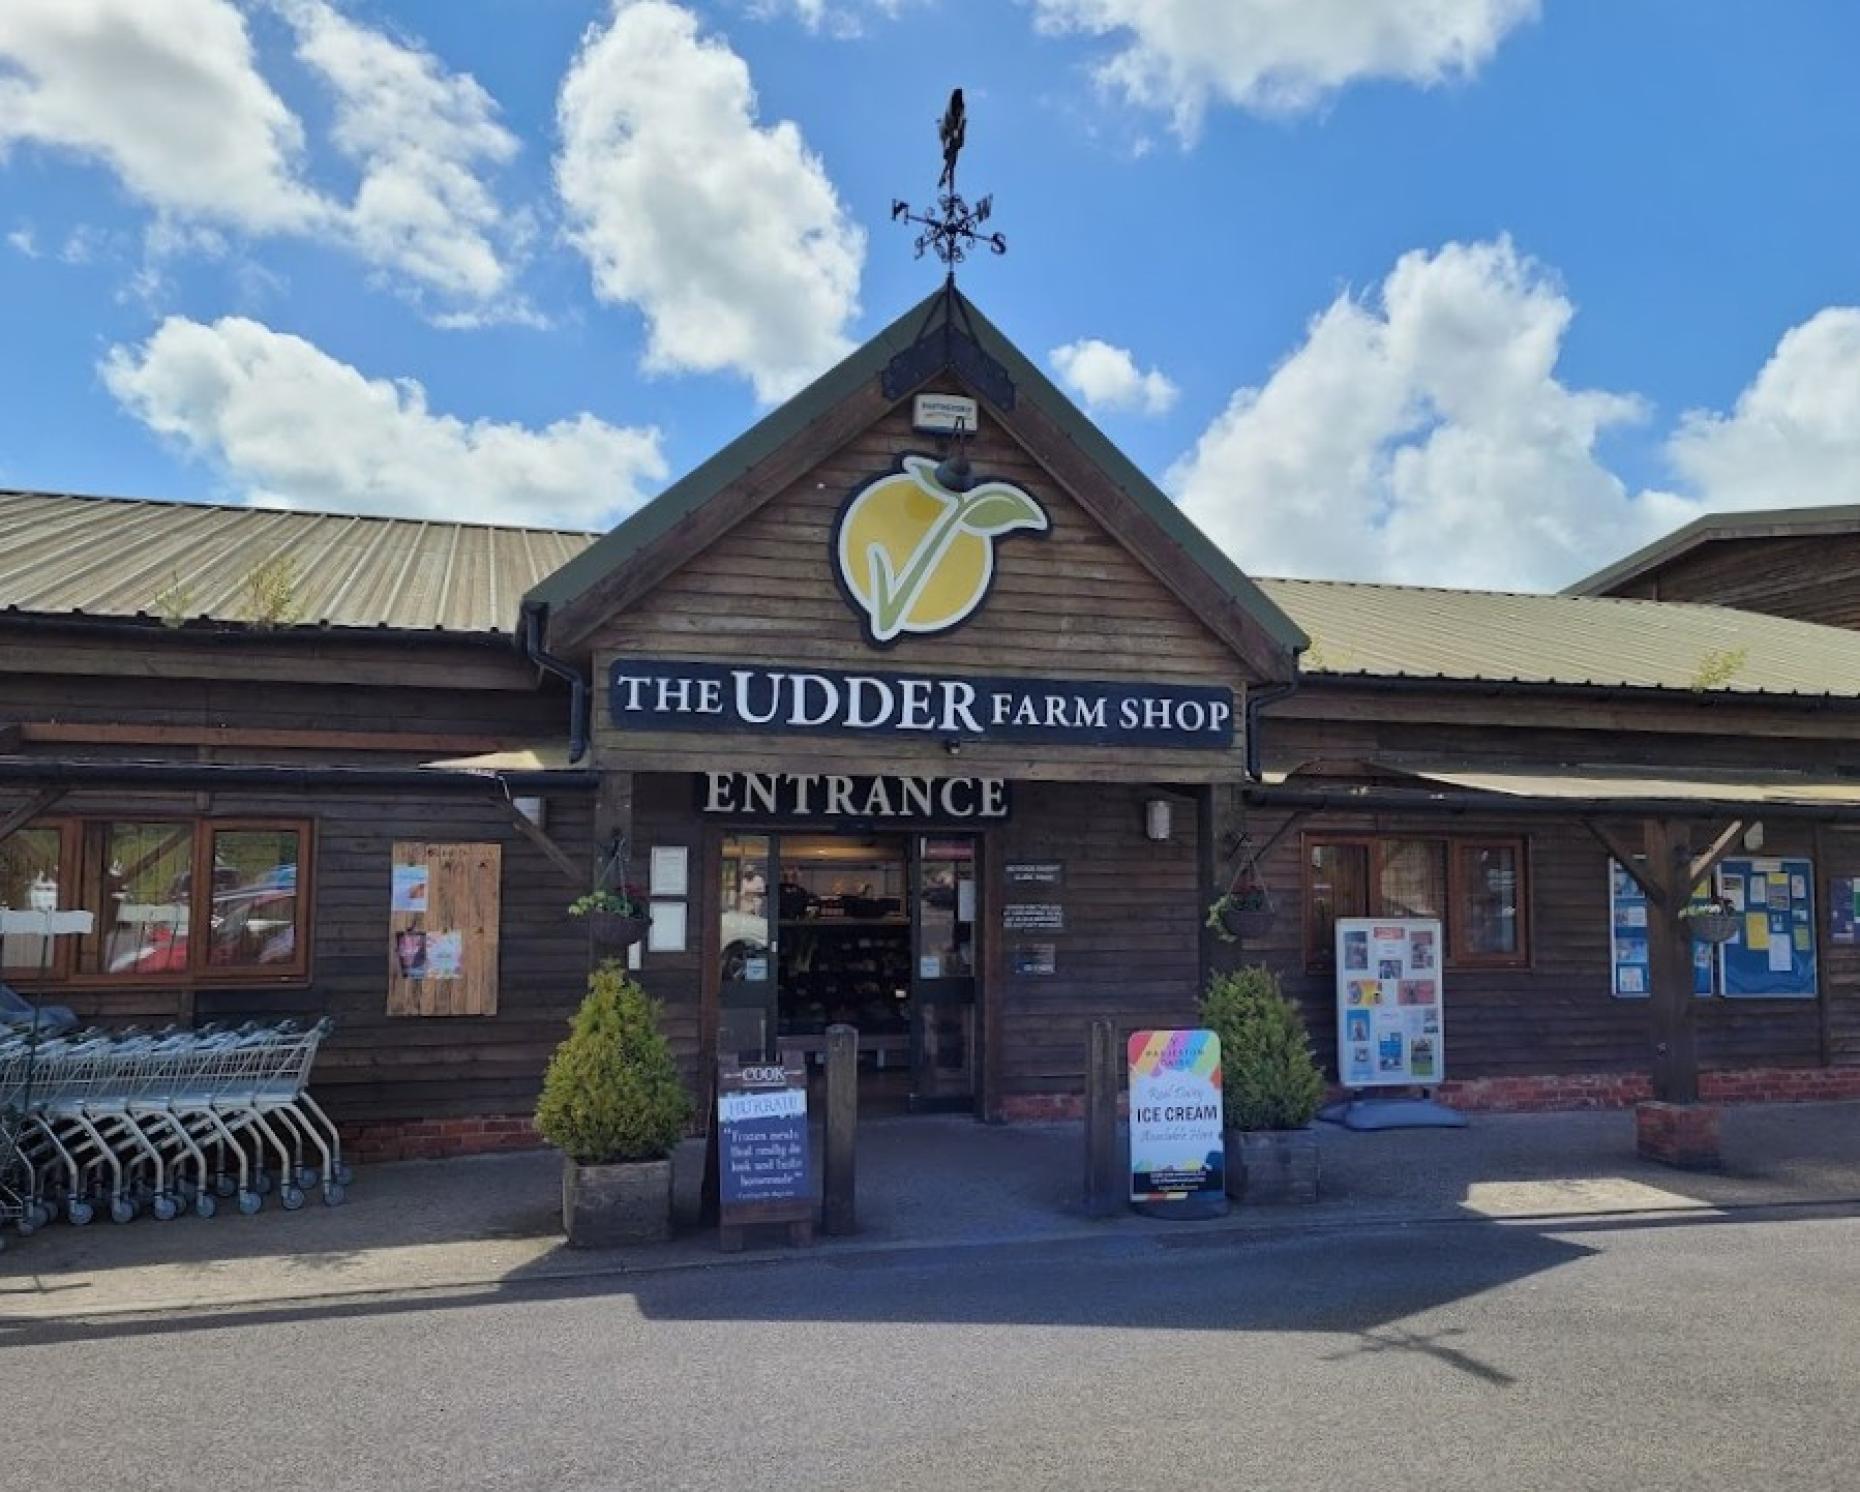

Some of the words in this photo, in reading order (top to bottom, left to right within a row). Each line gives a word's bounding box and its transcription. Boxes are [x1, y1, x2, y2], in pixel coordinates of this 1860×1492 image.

[617, 675, 724, 713] THE
[730, 670, 984, 733] UDDER
[990, 692, 1107, 728] FARM
[1118, 697, 1230, 731] SHOP
[703, 770, 1009, 817] ENTRANCE
[742, 1066, 786, 1082] COOK
[1137, 1106, 1162, 1124] ICE
[1165, 1105, 1218, 1123] CREAM
